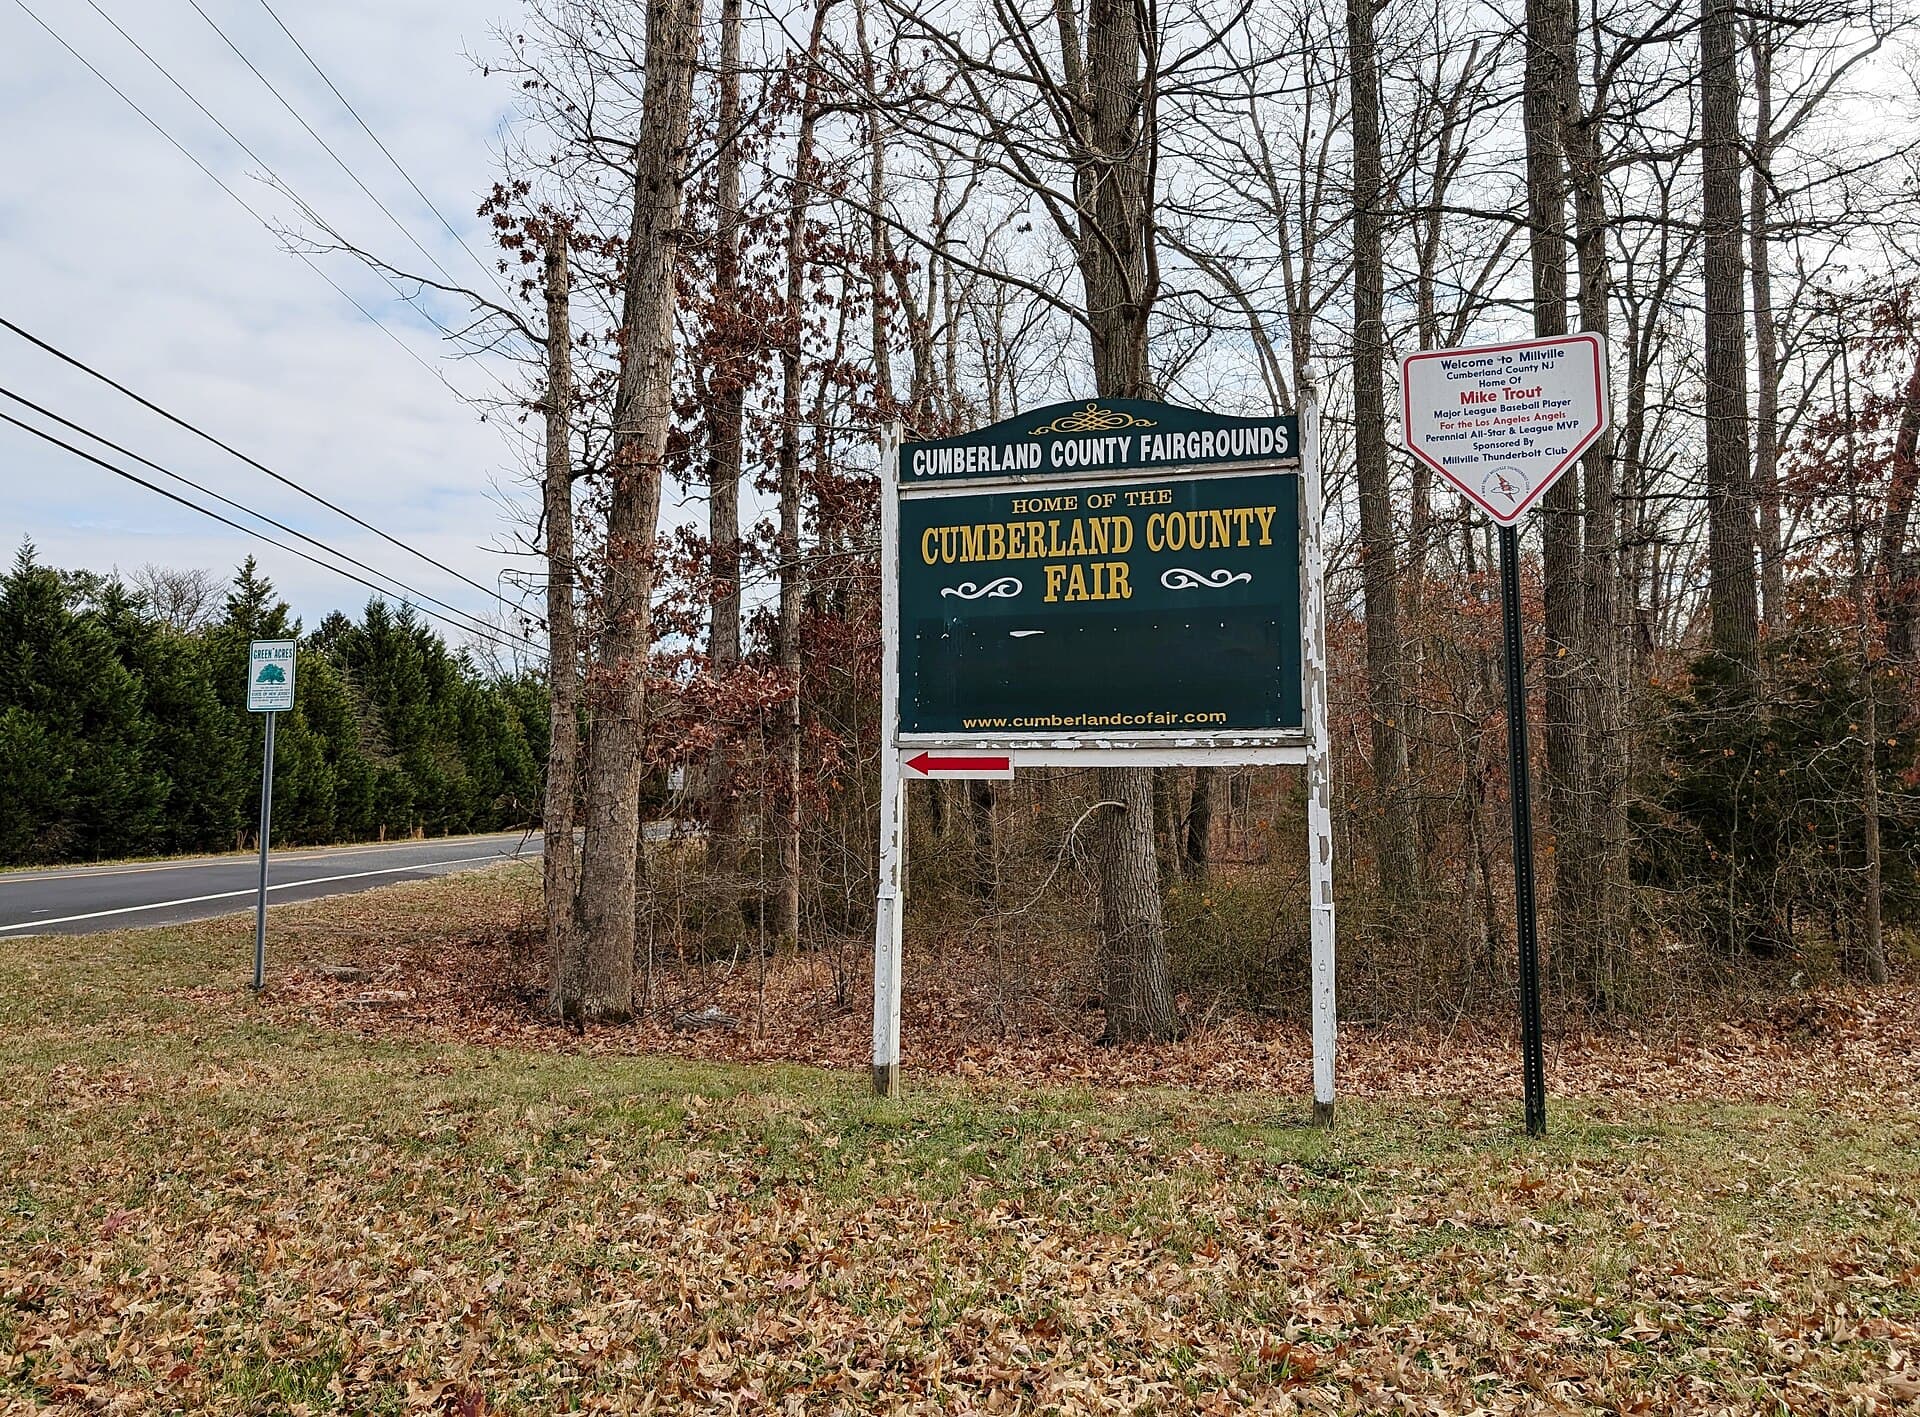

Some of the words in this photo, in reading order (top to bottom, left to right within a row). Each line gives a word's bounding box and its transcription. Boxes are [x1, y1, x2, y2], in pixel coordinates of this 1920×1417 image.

[1441, 357, 1493, 370] Welcome
[1501, 355, 1512, 364] to
[1520, 349, 1564, 362] Millville
[1447, 368, 1502, 380] Cumberland
[1506, 364, 1539, 376] County
[1542, 362, 1554, 370] NJ
[1479, 379, 1506, 388] Home
[1509, 377, 1522, 385] Of
[1460, 389, 1497, 404] Mike
[1502, 386, 1542, 401] Trout
[1434, 409, 1461, 420] Major
[1464, 405, 1497, 417] League
[1500, 402, 1540, 412] Baseball
[1543, 399, 1571, 409] Player
[1440, 422, 1454, 430] For
[1458, 420, 1472, 428] the
[1476, 418, 1490, 427] Los
[1493, 415, 1530, 426] Angeles
[1534, 411, 1566, 422] Angels
[1426, 432, 1467, 442] Perennial
[1471, 428, 1506, 439] All-Star
[1509, 427, 1516, 435] &
[1519, 425, 1553, 436] League
[1557, 421, 1579, 430] MVP
[912, 443, 1041, 476] CUMBERLAND
[1051, 436, 1132, 468] COUNTY
[1140, 425, 1288, 461] FAIRGROUNDS
[1473, 439, 1521, 452] Sponsored
[1524, 438, 1534, 448] By
[1442, 455, 1479, 465] Millville
[1483, 450, 1541, 462] Thunderbolt
[1545, 447, 1568, 456] Club
[1012, 496, 1078, 514] HOME
[1087, 493, 1116, 509] OF
[1125, 490, 1172, 506] THE
[921, 515, 1134, 566] CUMBERLAND
[1146, 506, 1276, 552] COUNTY
[1043, 561, 1132, 603] FAIR
[254, 649, 271, 659] GREEN
[275, 648, 292, 658] ACRES
[963, 710, 1227, 728] www.cumberlandcofair.com
